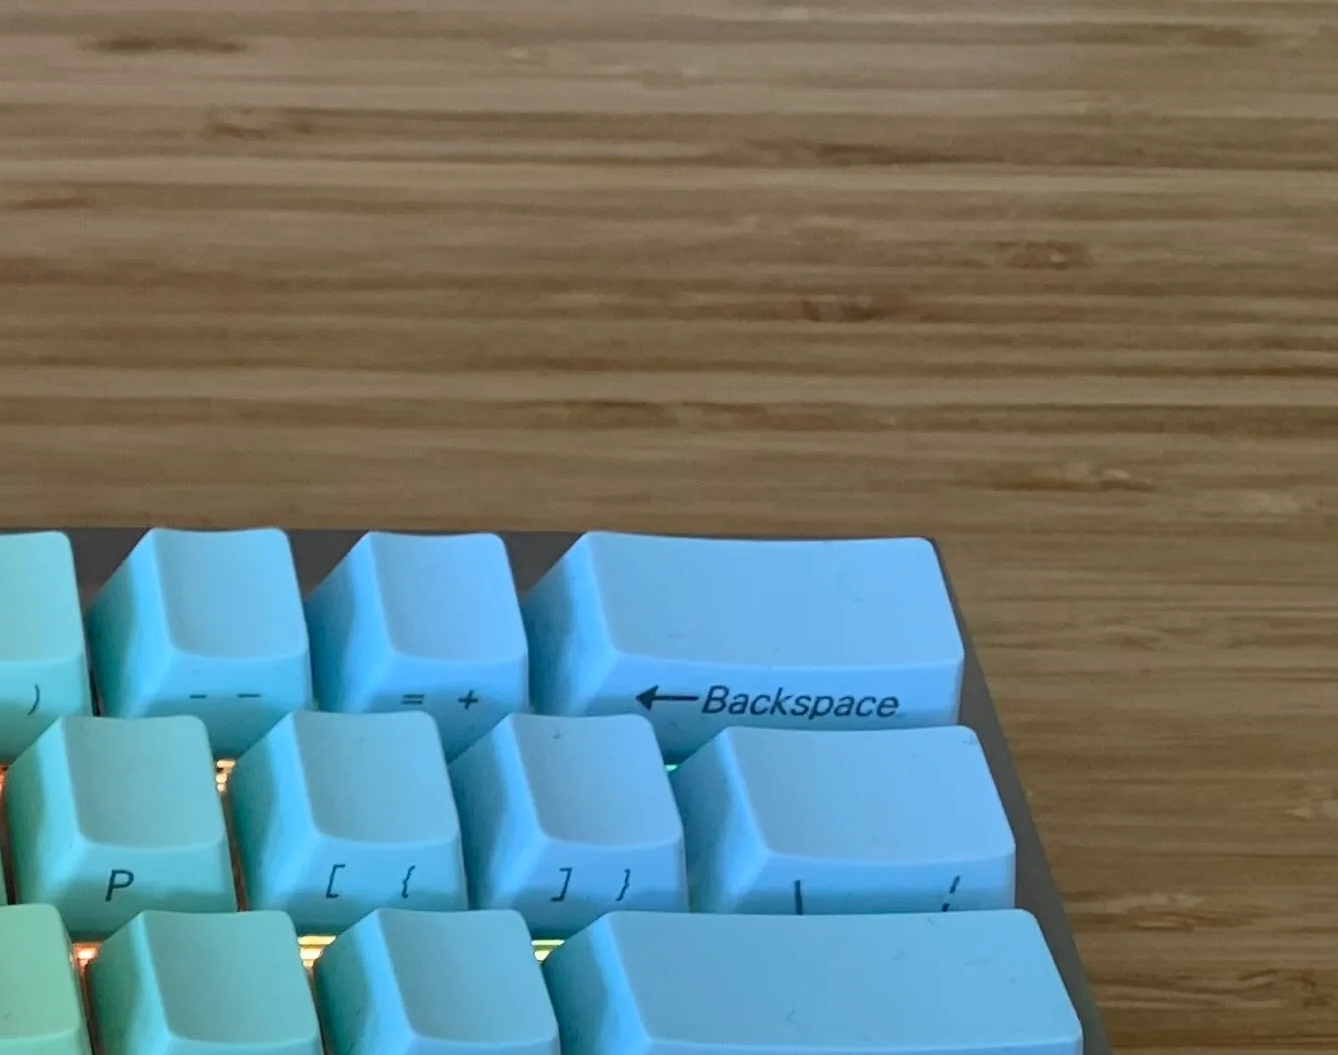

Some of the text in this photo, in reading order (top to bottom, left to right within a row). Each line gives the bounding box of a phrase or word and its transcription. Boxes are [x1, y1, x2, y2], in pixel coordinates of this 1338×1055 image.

[27, 683, 41, 716] )
[399, 689, 479, 710] = +
[701, 684, 900, 721] Backspace
[105, 868, 135, 902] P
[325, 863, 416, 900] [ {
[550, 867, 632, 903] ] }
